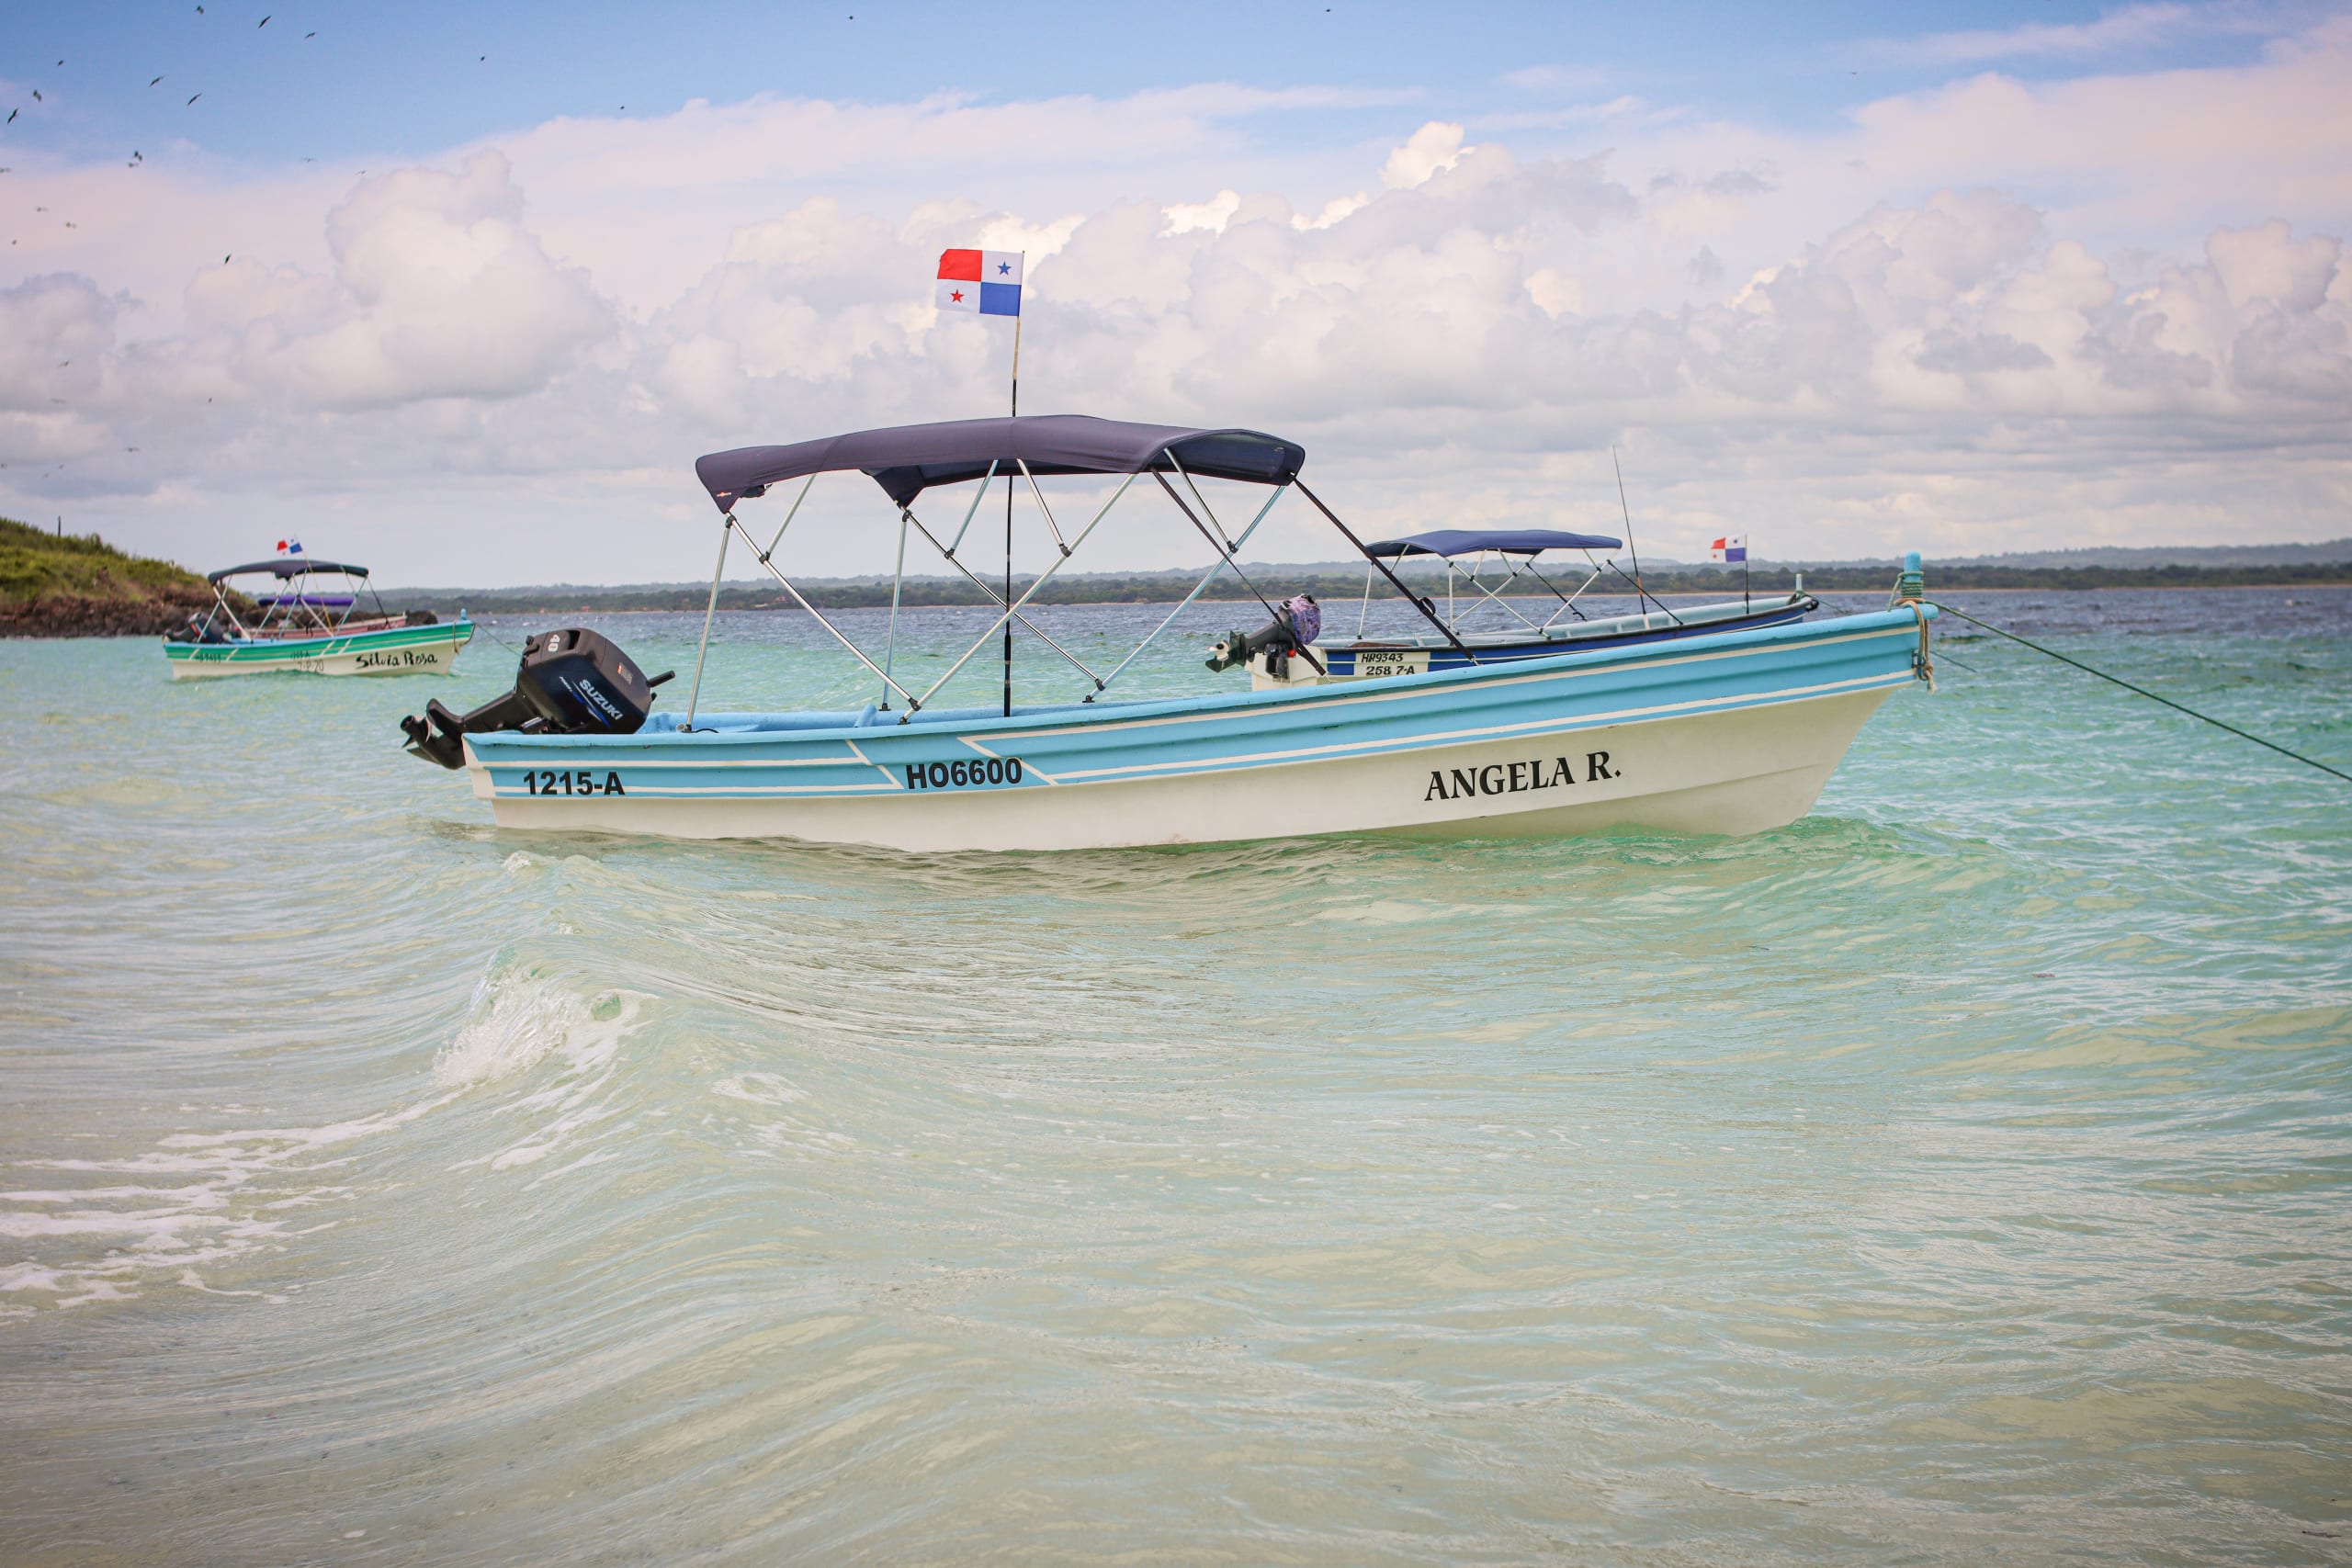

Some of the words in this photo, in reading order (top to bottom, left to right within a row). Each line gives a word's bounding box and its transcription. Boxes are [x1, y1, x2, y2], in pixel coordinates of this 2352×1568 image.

[355, 650, 400, 670] Silvia
[403, 650, 438, 665] Rosa
[1365, 665, 1392, 676] 258
[579, 679, 624, 720] SUZUKI
[523, 771, 626, 795] 1215-A
[905, 758, 1023, 789] HO6600
[1424, 757, 1576, 801] ANGELA
[1586, 750, 1622, 782] R.
